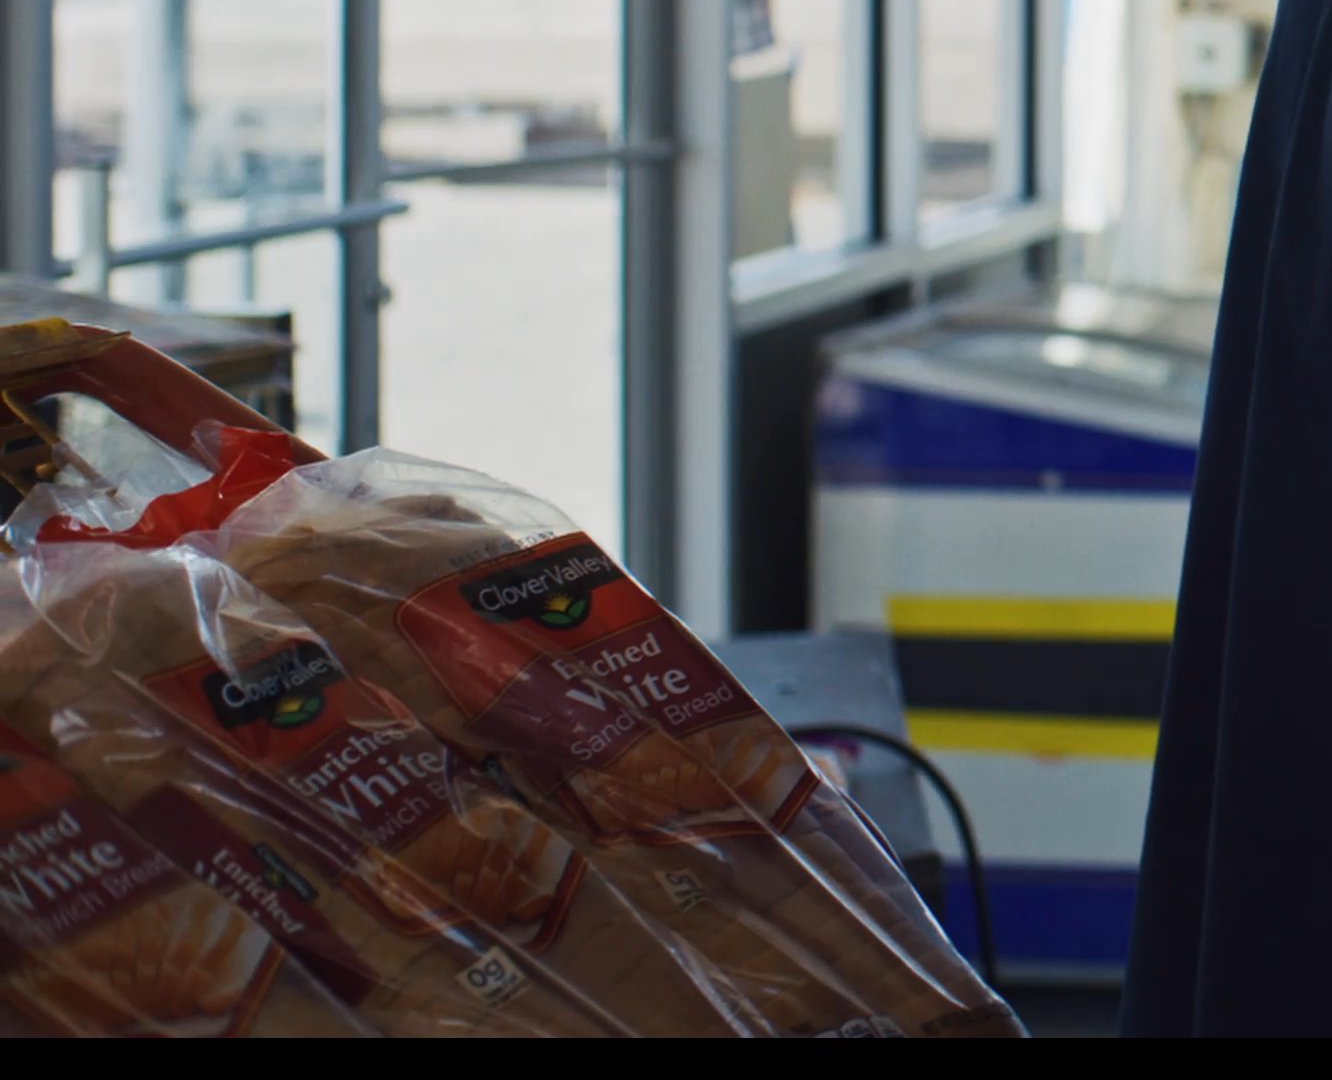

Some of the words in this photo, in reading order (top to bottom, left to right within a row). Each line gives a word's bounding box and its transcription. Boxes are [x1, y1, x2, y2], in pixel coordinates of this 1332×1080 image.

[550, 631, 662, 681] Eched
[571, 707, 640, 762] Sand
[663, 681, 735, 727] Bread
